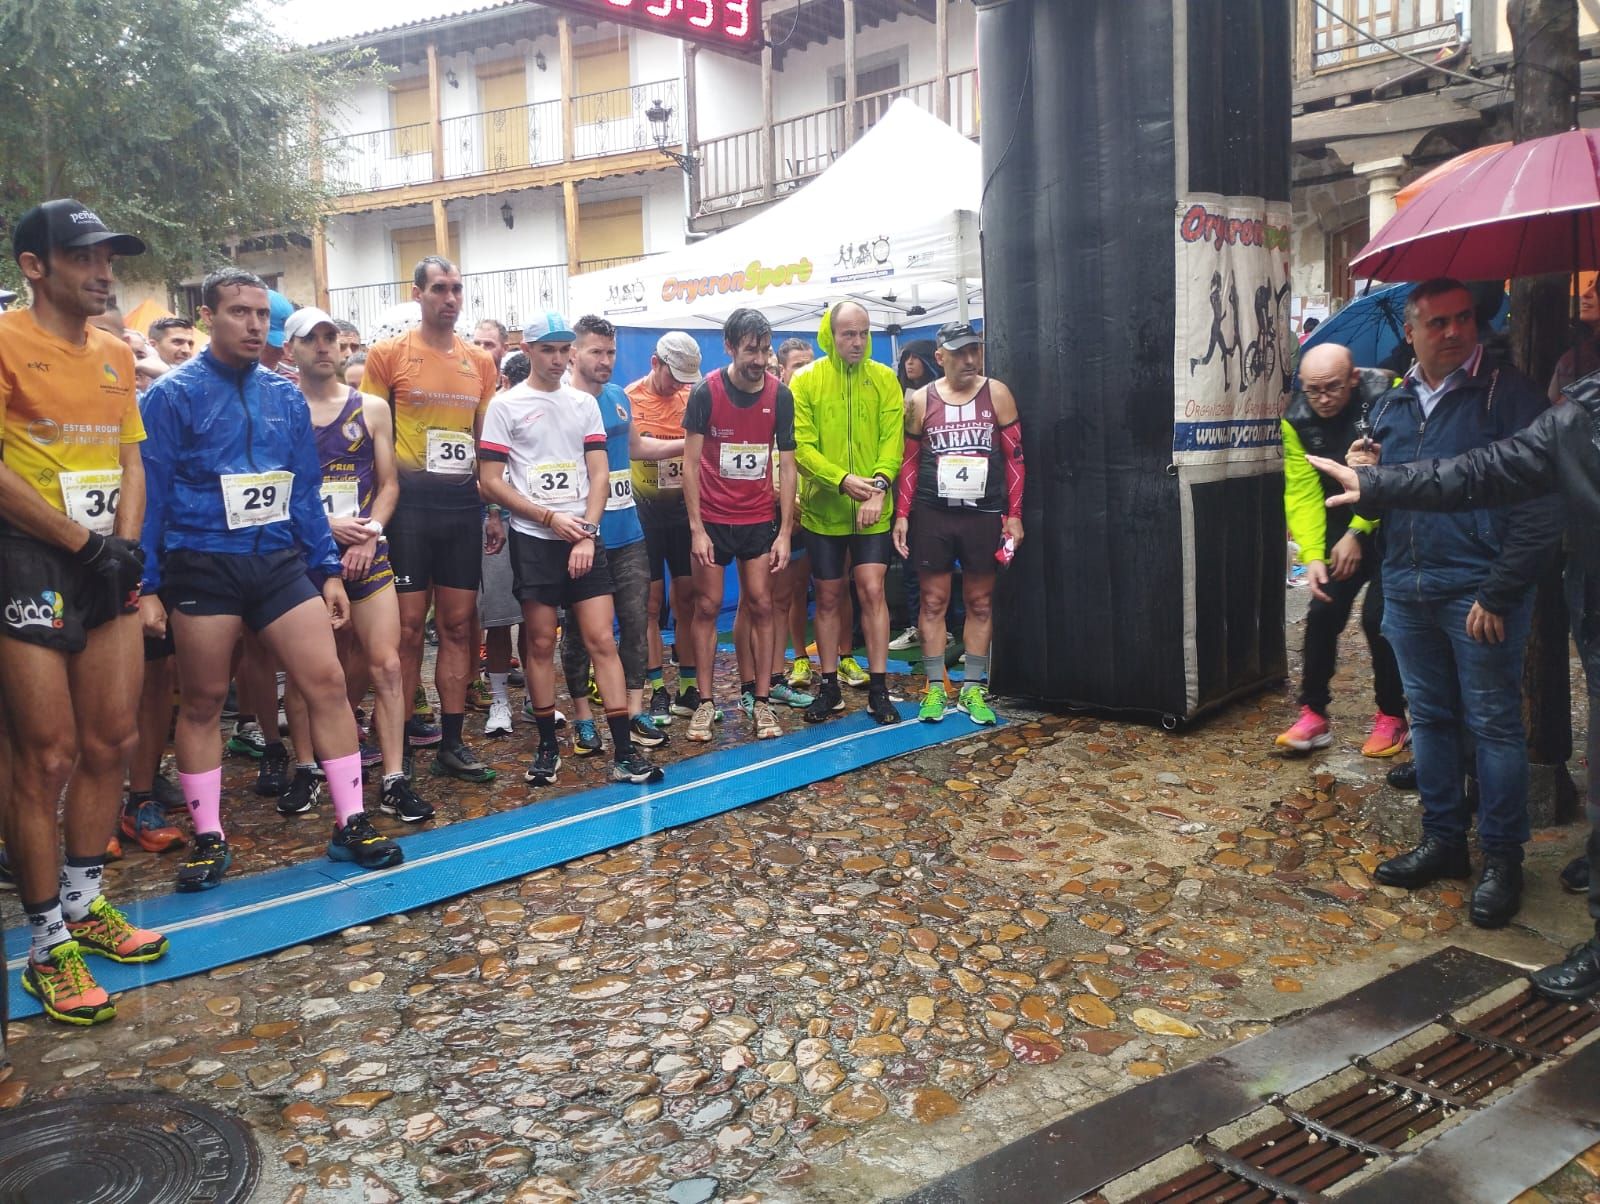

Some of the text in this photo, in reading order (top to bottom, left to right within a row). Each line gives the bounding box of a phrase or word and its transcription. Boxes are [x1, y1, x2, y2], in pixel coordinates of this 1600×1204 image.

[63, 423, 92, 432] ESTER
[927, 421, 994, 433] RUNNING
[929, 427, 992, 450] LA RAYA
[440, 442, 466, 461] 36
[732, 454, 757, 469] 13
[541, 472, 569, 491] 32
[955, 466, 969, 482] 4
[243, 486, 277, 511] 29
